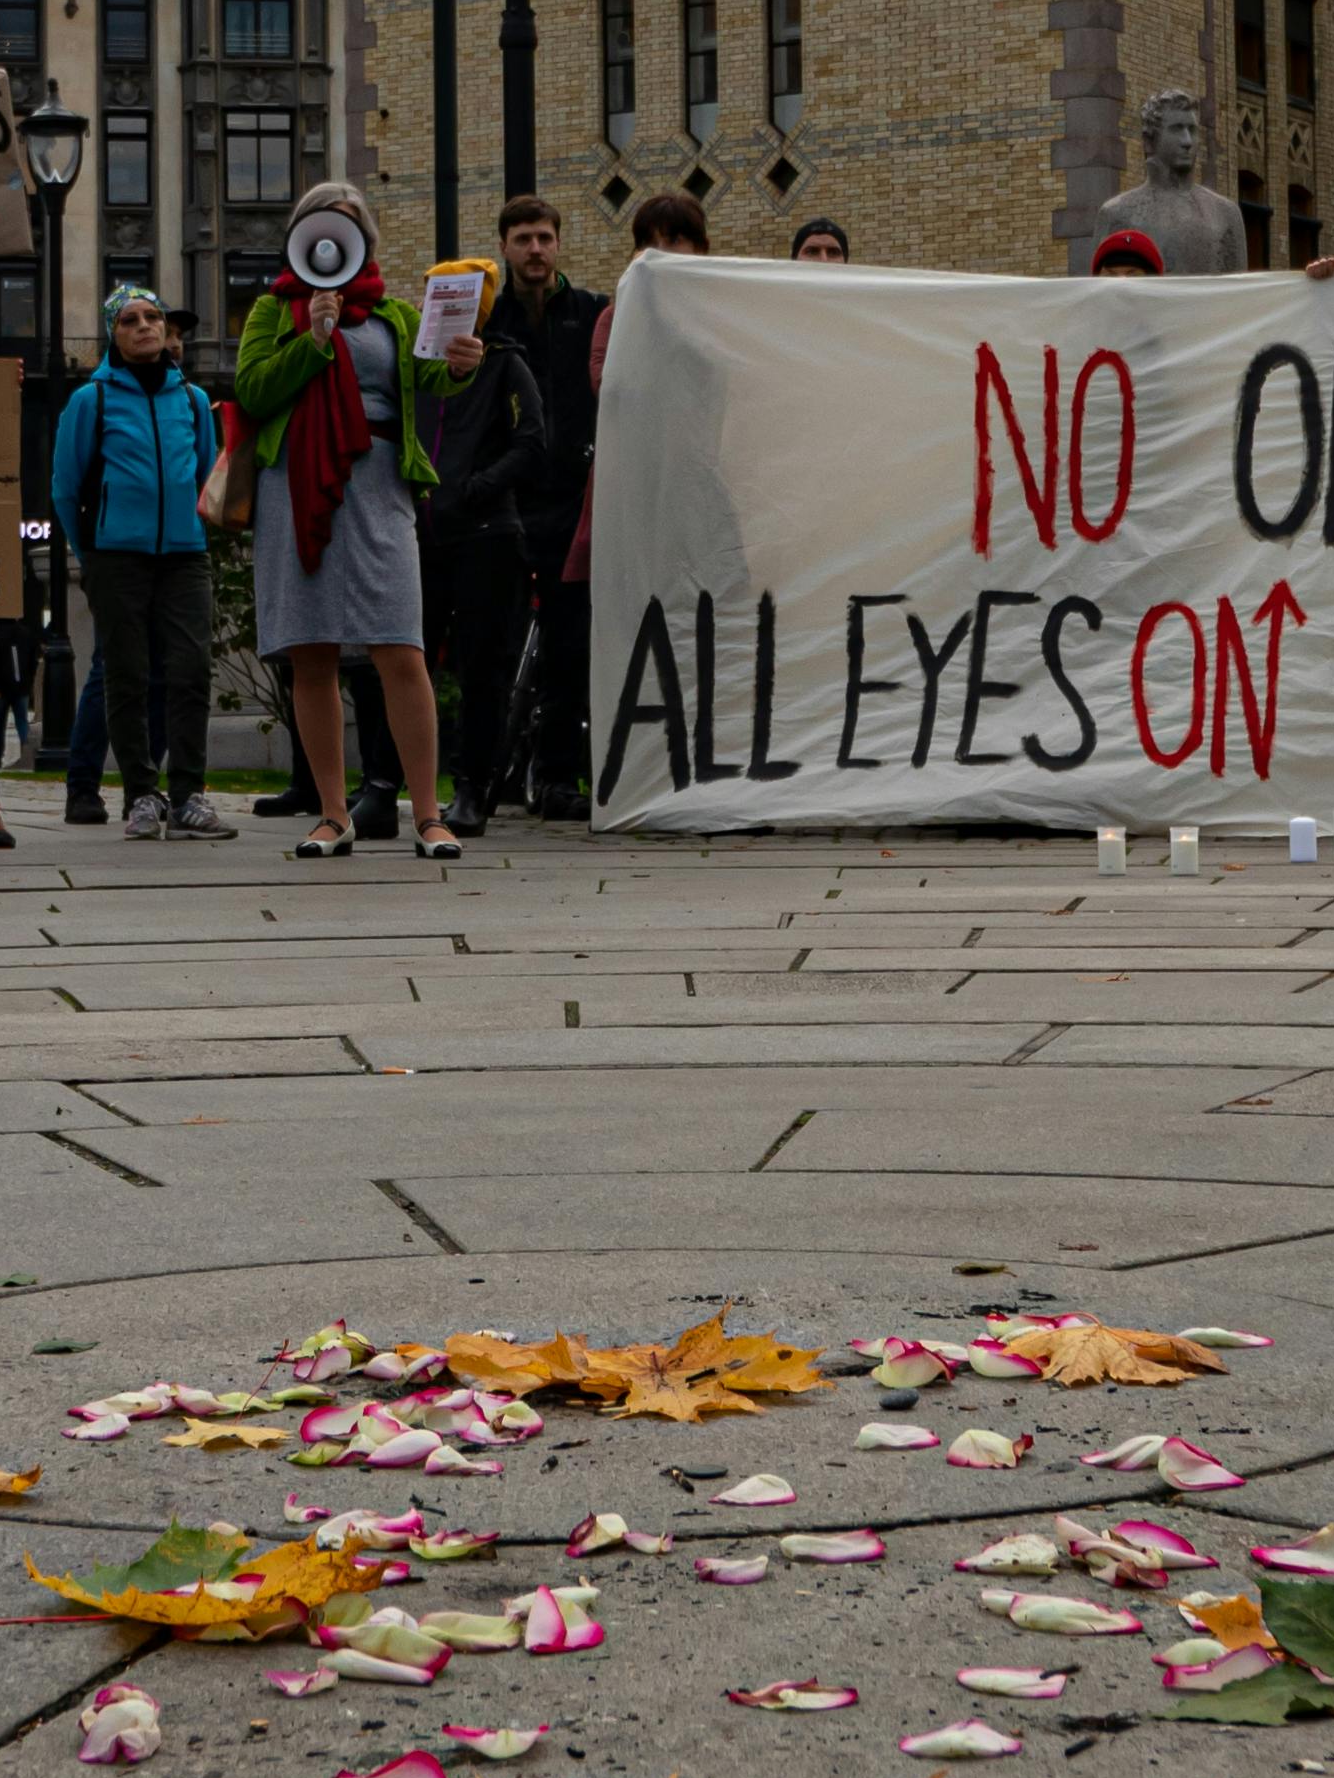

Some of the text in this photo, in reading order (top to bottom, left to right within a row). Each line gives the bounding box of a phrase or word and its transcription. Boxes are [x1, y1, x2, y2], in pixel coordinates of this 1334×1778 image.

[972, 341, 1136, 558] NO
[597, 589, 802, 807] ALL
[836, 590, 1103, 772] EYES
[1131, 580, 1308, 782] ON
